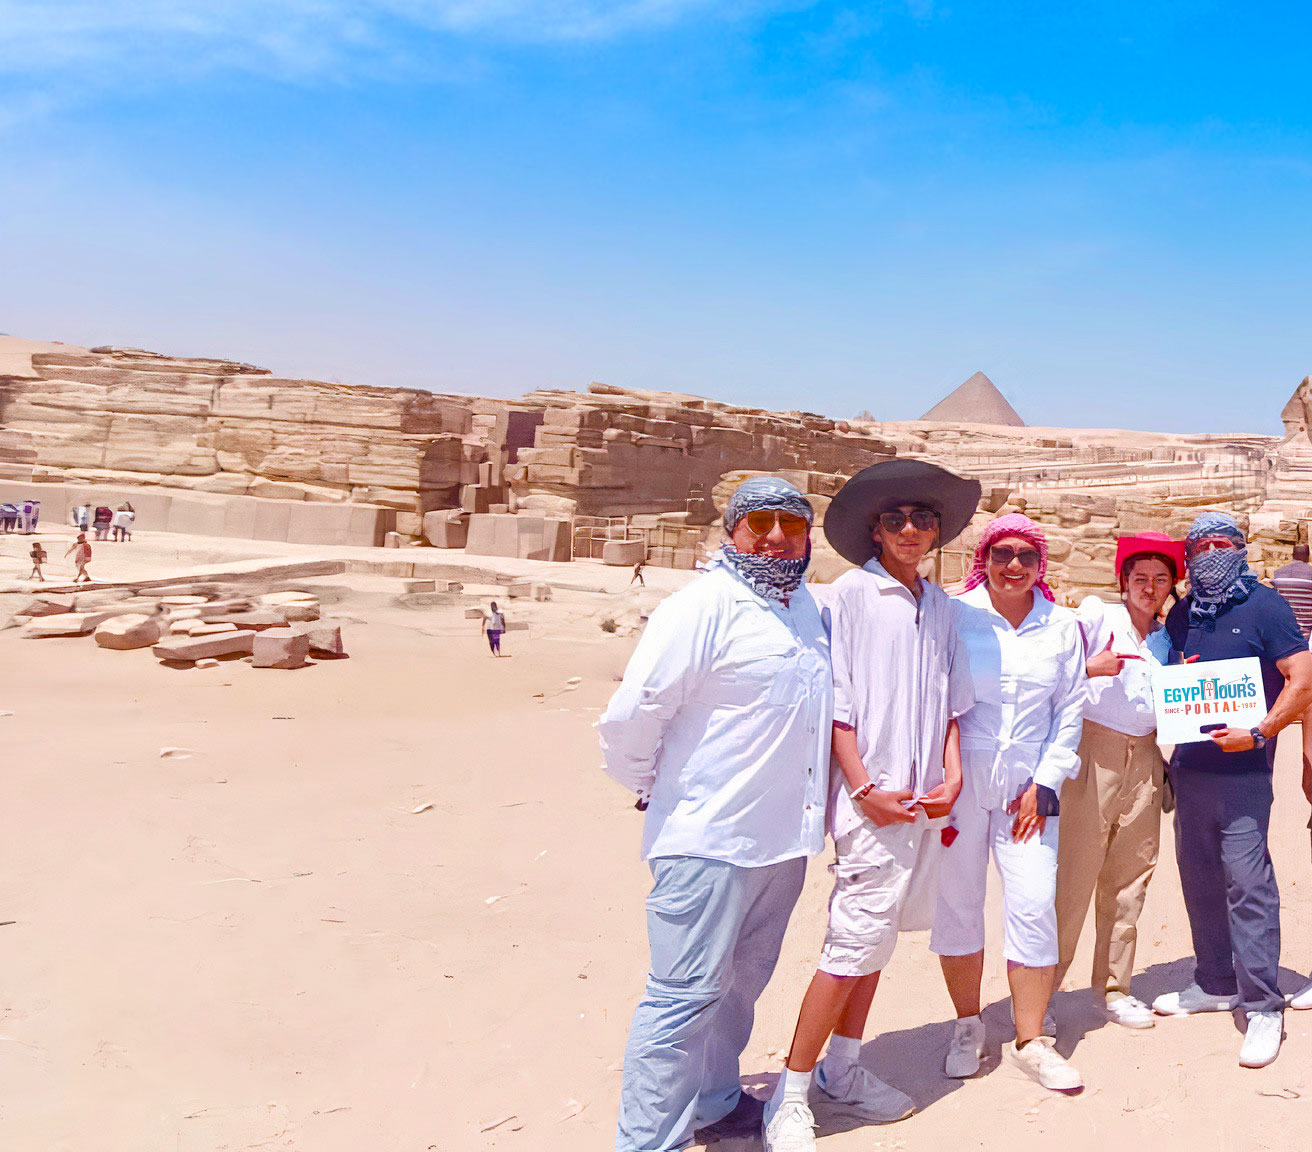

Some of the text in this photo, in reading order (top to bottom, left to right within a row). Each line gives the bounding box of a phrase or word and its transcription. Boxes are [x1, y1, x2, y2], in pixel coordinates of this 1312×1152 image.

[1164, 678, 1256, 703] EGYPT TOURS
[1184, 701, 1239, 715] PORTAL
